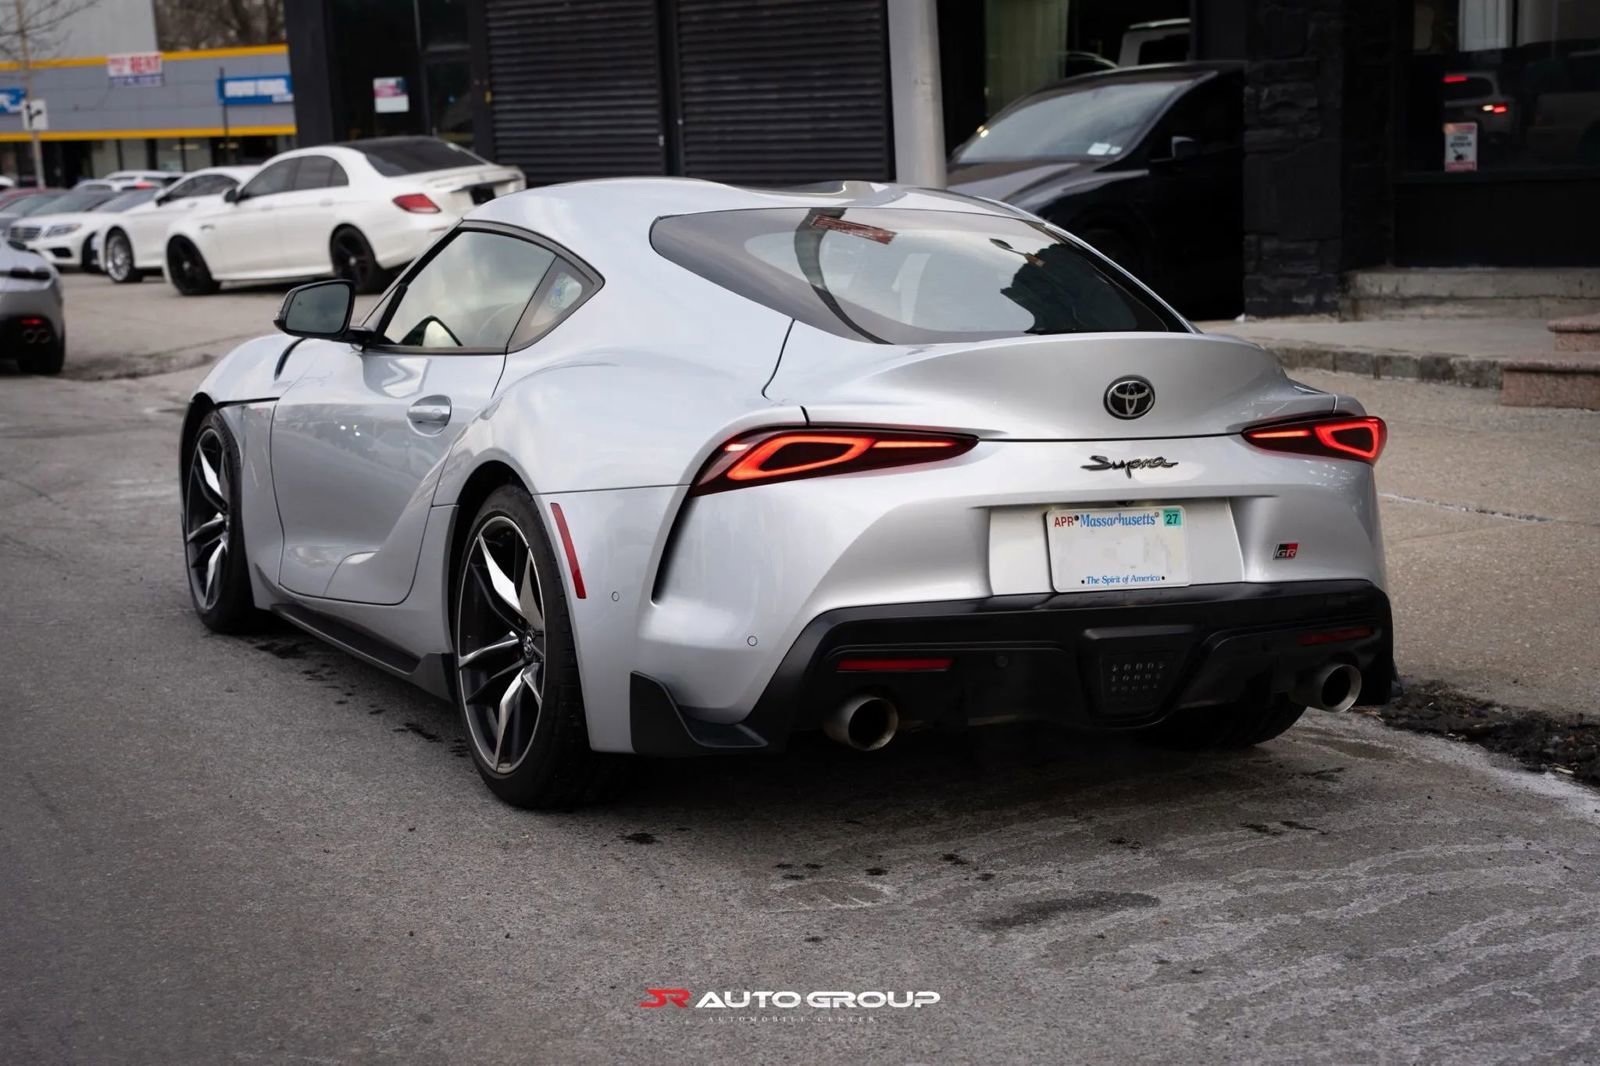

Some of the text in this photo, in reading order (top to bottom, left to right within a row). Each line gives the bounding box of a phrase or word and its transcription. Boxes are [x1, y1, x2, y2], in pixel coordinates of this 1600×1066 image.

[1080, 455, 1179, 479] Supra
[1054, 516, 1074, 527] APR
[1080, 512, 1156, 527] Massachusetts
[1166, 514, 1179, 525] 27
[1086, 574, 1161, 585] The Spirit of America
